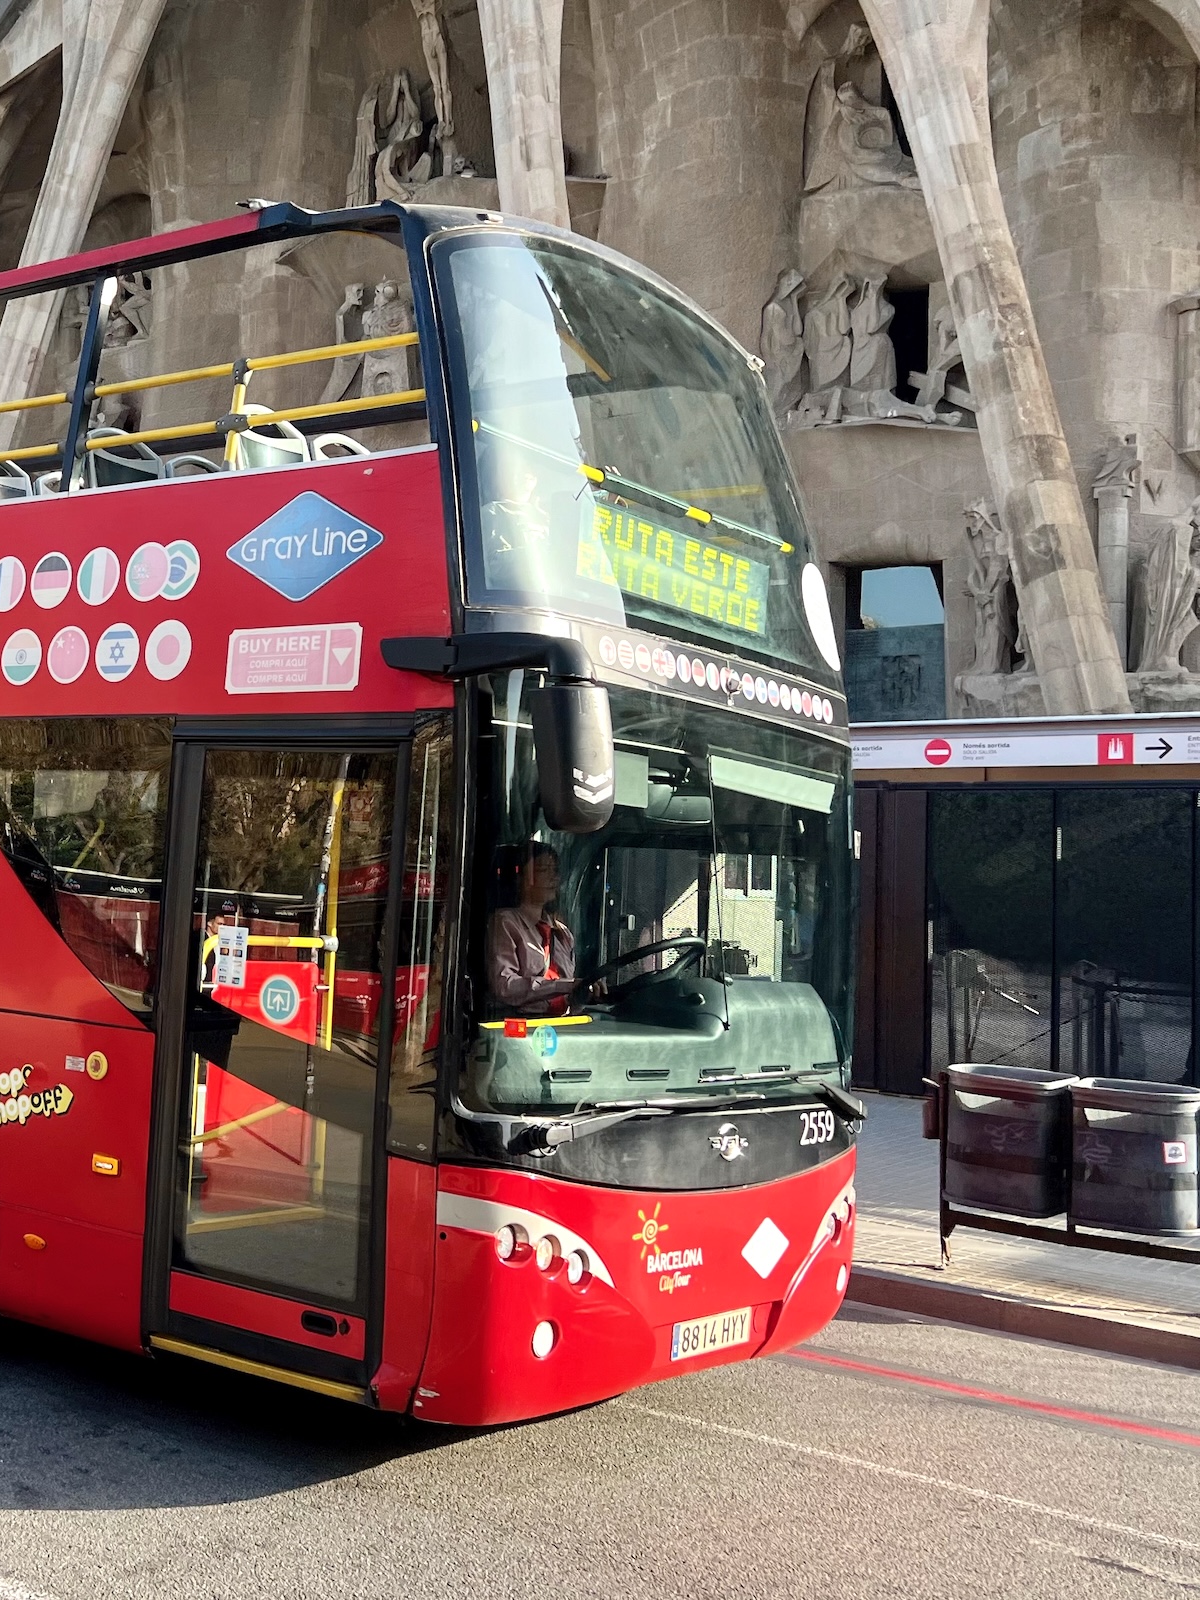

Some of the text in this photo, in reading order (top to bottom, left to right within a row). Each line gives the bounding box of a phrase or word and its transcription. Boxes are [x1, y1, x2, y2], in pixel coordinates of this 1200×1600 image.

[241, 527, 368, 562] Gray Line
[592, 505, 750, 594] RUTA ESTE
[577, 541, 759, 632] RUTA VERDE
[239, 635, 321, 654] BUY HERE
[250, 658, 284, 669] COMPRI
[247, 673, 284, 684] COMPRE
[31, 1085, 63, 1113] off
[800, 1109, 835, 1146] 2559
[647, 1247, 703, 1274] BARCELONA
[659, 1271, 691, 1295] City Tour
[681, 1320, 717, 1353] 8814
[721, 1313, 747, 1343] HYY
